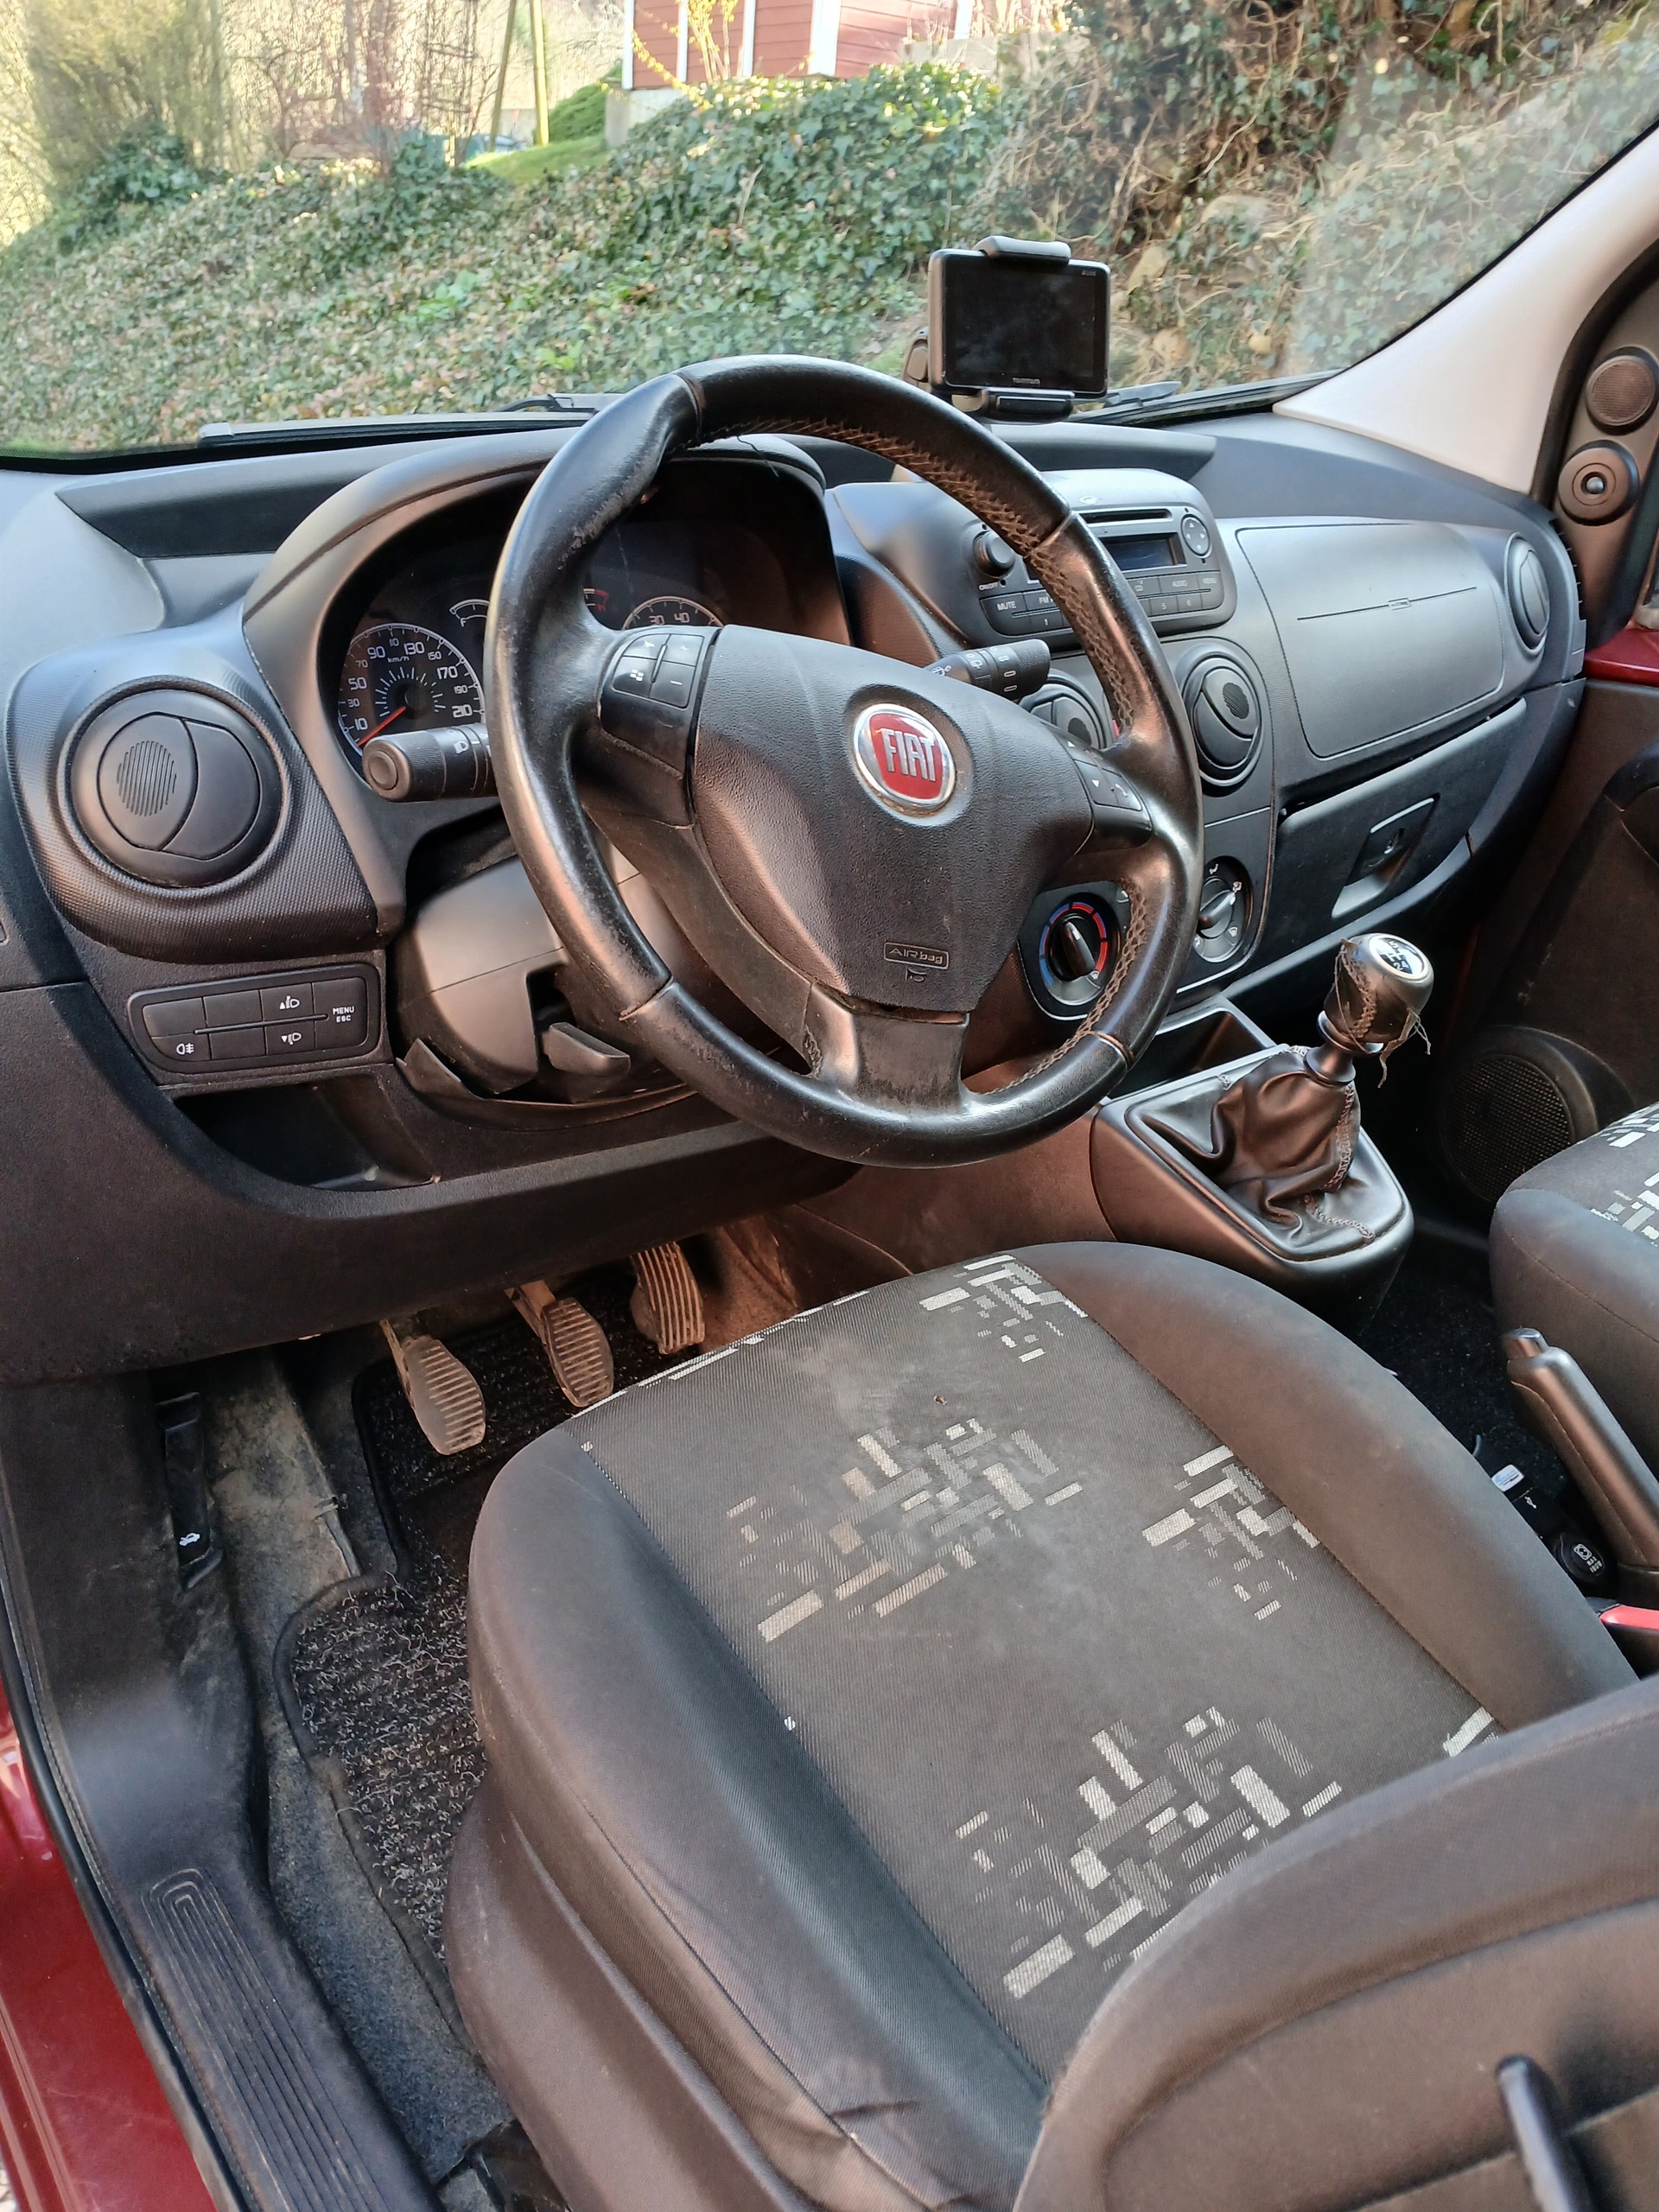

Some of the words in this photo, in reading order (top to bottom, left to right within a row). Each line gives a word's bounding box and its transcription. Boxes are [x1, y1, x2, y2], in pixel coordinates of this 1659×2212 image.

[997, 601, 1017, 611] MUTE
[649, 614, 665, 626] 30
[673, 612, 690, 623] 40
[367, 646, 386, 659] 90
[404, 642, 425, 656] 130
[428, 651, 442, 661] 150
[437, 666, 458, 679] 170
[348, 677, 367, 690] 50
[454, 685, 467, 695] 190
[347, 698, 359, 708] 30
[452, 704, 473, 718] 210
[354, 717, 368, 730] 10
[880, 728, 937, 782] FIAT
[1393, 962, 1404, 970] 2
[333, 1006, 354, 1015] MENU
